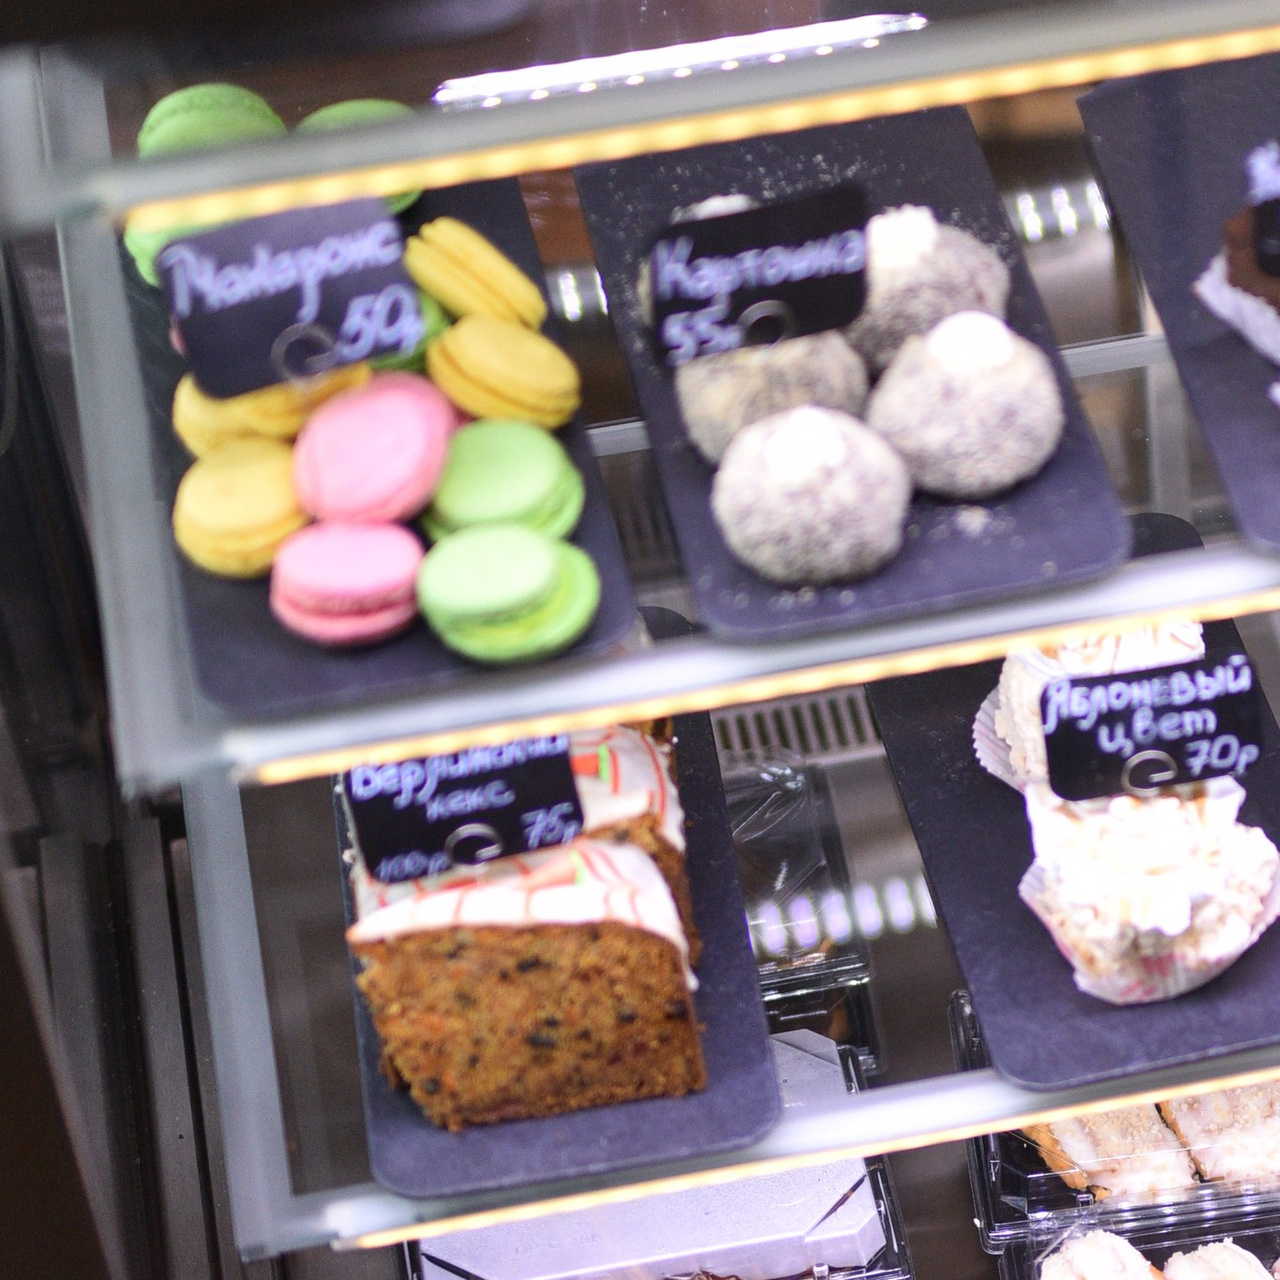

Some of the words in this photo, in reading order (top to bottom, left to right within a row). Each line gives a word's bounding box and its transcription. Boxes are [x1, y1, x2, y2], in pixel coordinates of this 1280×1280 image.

[653, 229, 867, 320] Картошка
[1043, 655, 1252, 736] Яблоневый
[1097, 705, 1218, 758] цвет
[1184, 733, 1260, 777] 70р
[425, 779, 516, 823] кекс
